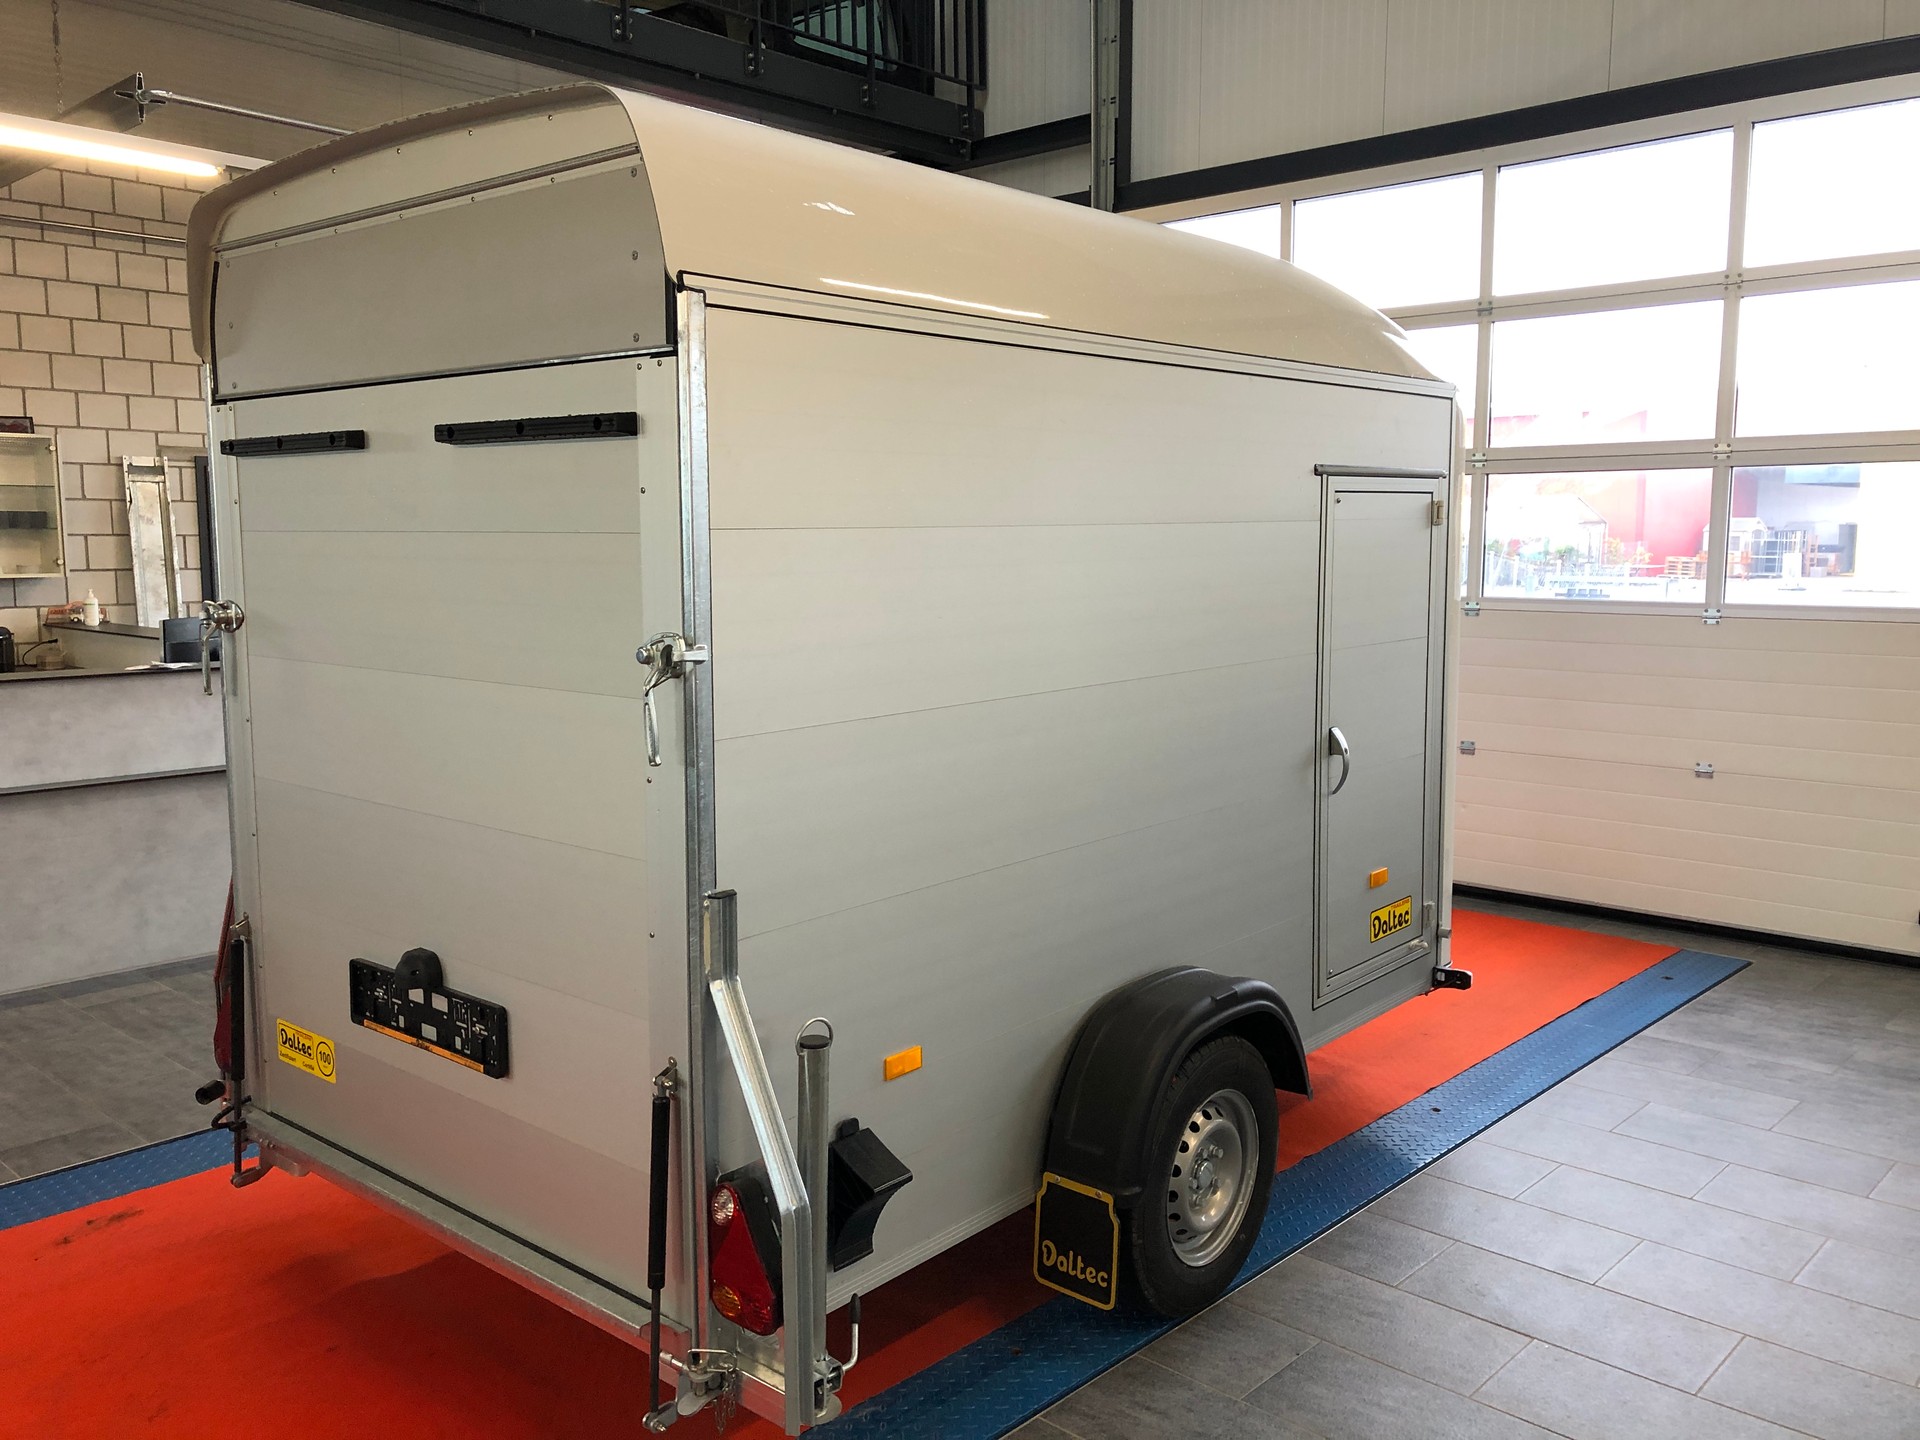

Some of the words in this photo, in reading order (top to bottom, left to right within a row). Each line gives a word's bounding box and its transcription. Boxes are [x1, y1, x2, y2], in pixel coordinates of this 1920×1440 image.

[1373, 910, 1409, 939] Daltec
[280, 1028, 312, 1057] Daltec
[319, 1050, 331, 1065] 100
[1042, 1240, 1108, 1288] Daltec
